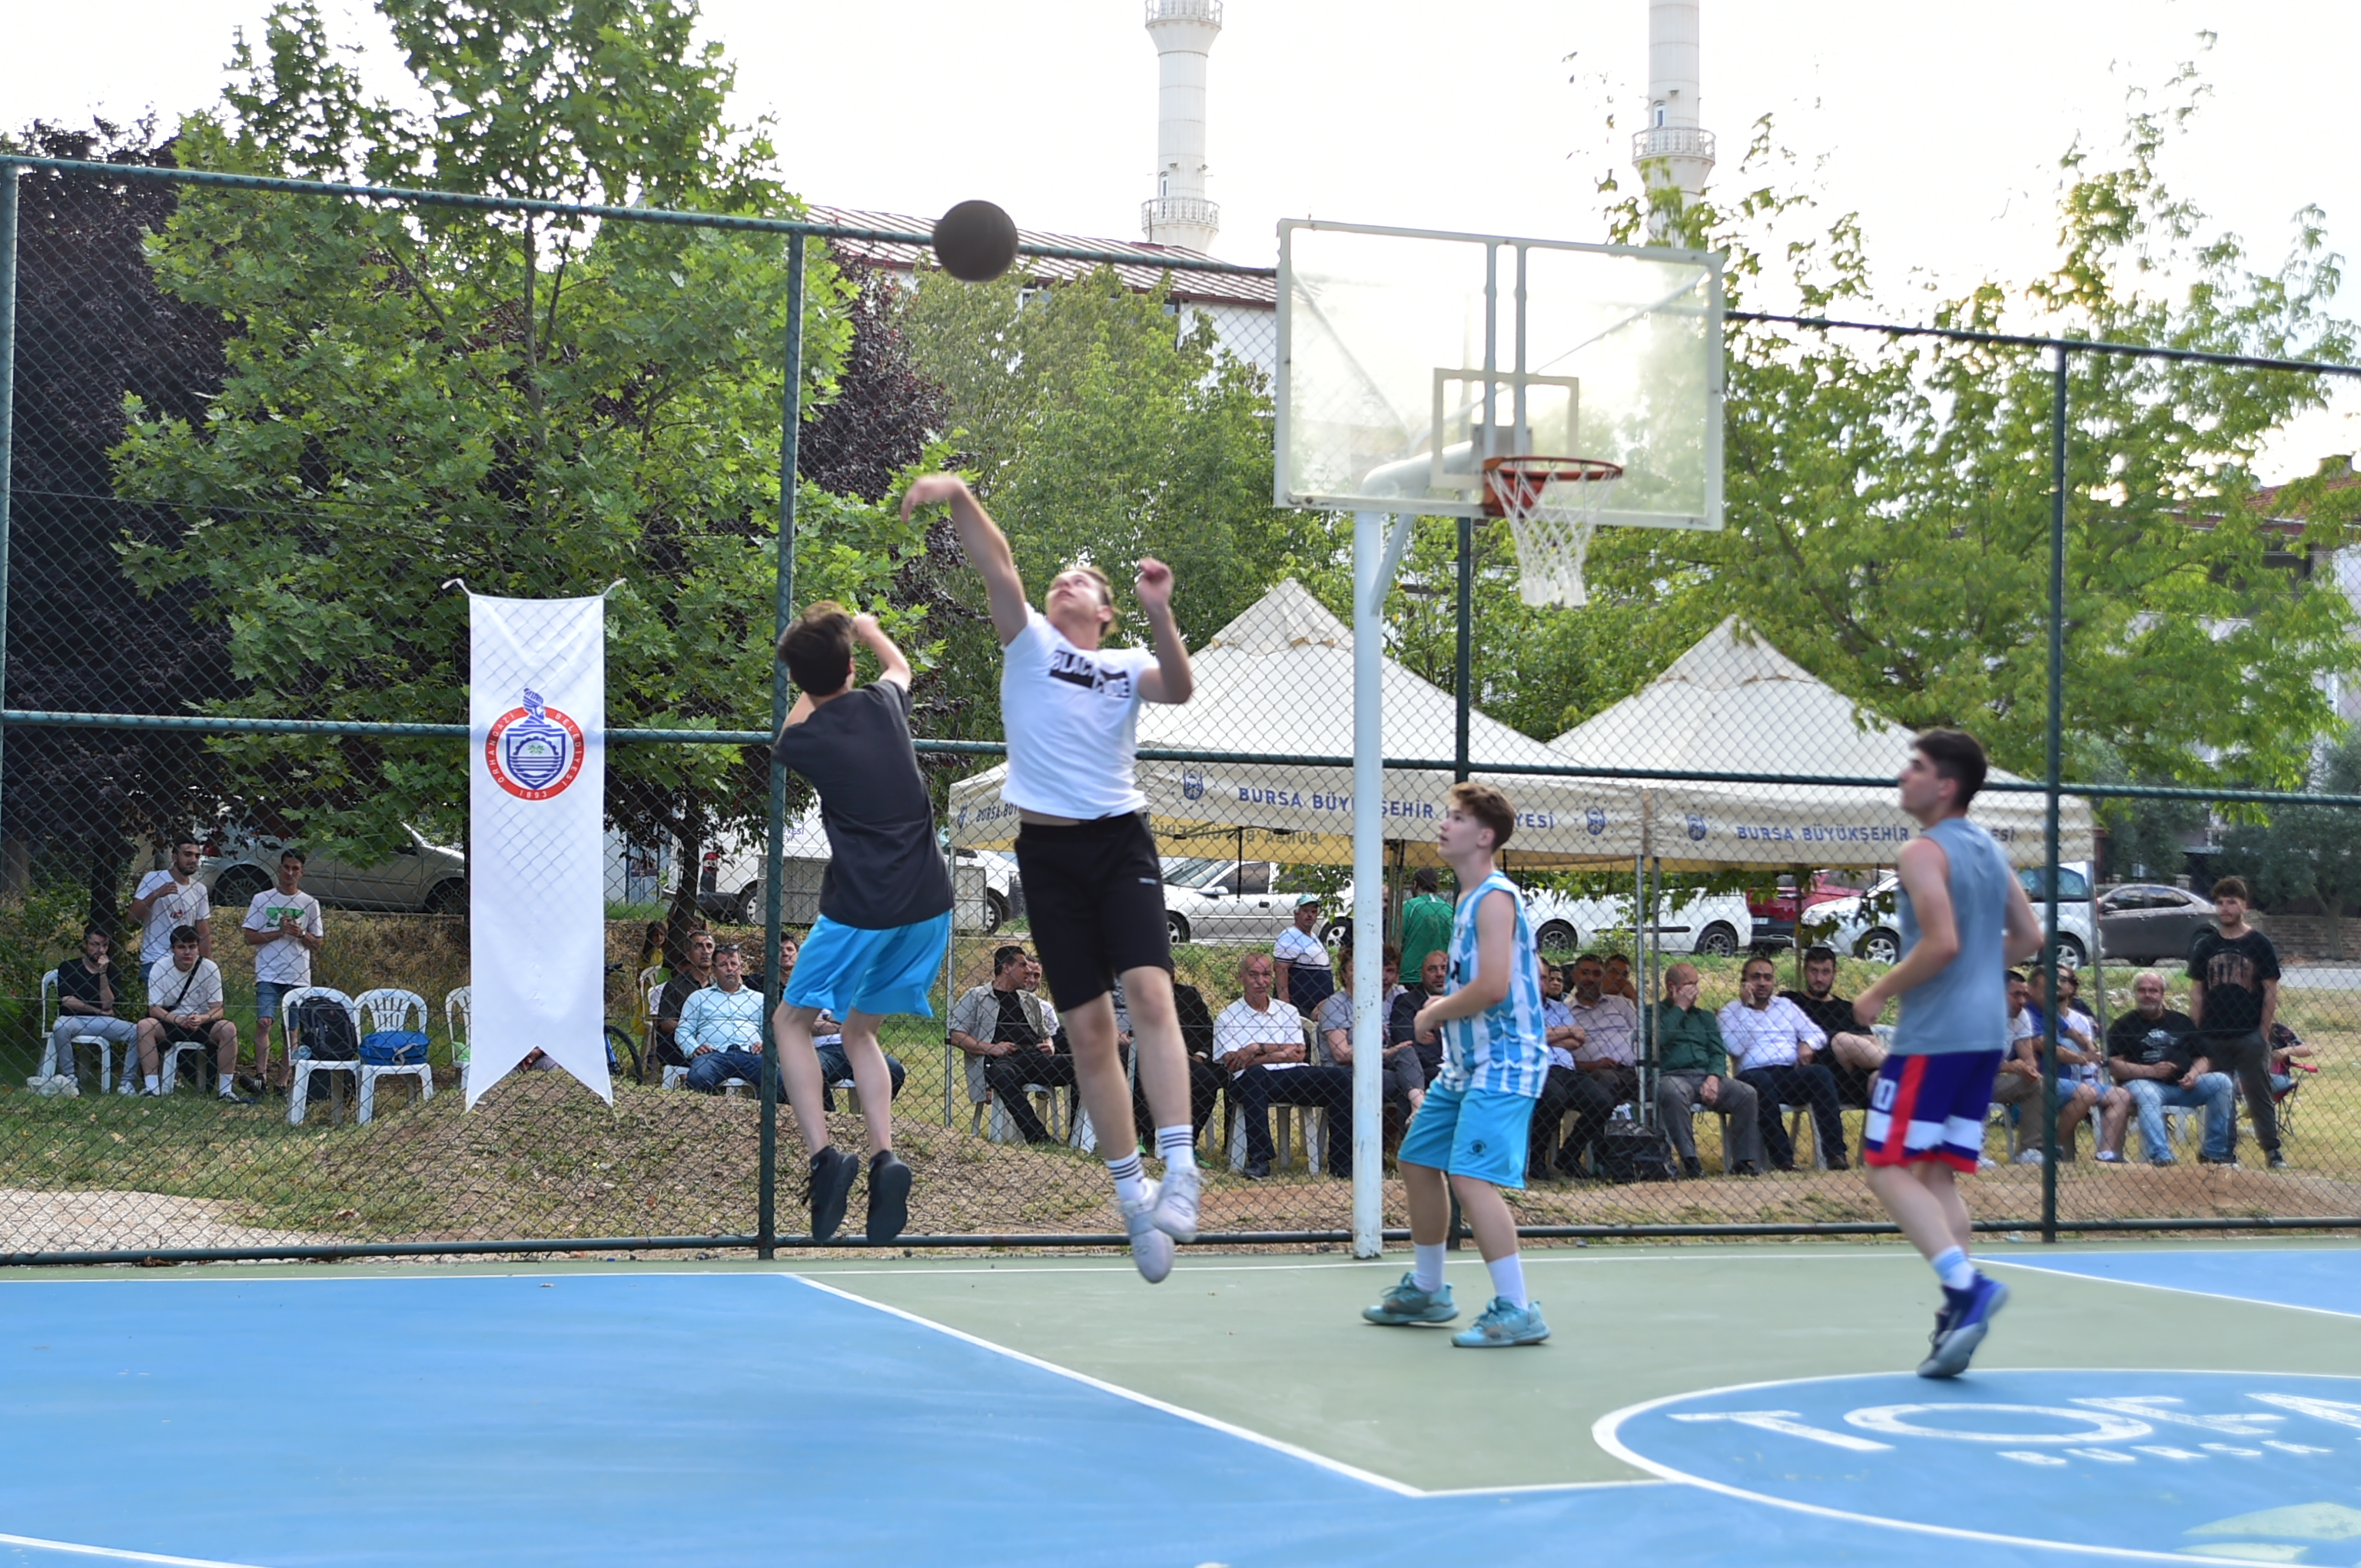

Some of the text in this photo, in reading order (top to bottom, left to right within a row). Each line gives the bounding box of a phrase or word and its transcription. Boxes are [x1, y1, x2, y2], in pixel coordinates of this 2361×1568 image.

[519, 789, 548, 799] 1893
[1238, 787, 1303, 807] BURSA
[1736, 823, 1910, 845] BURSA BÜYÜKŞEHİR
